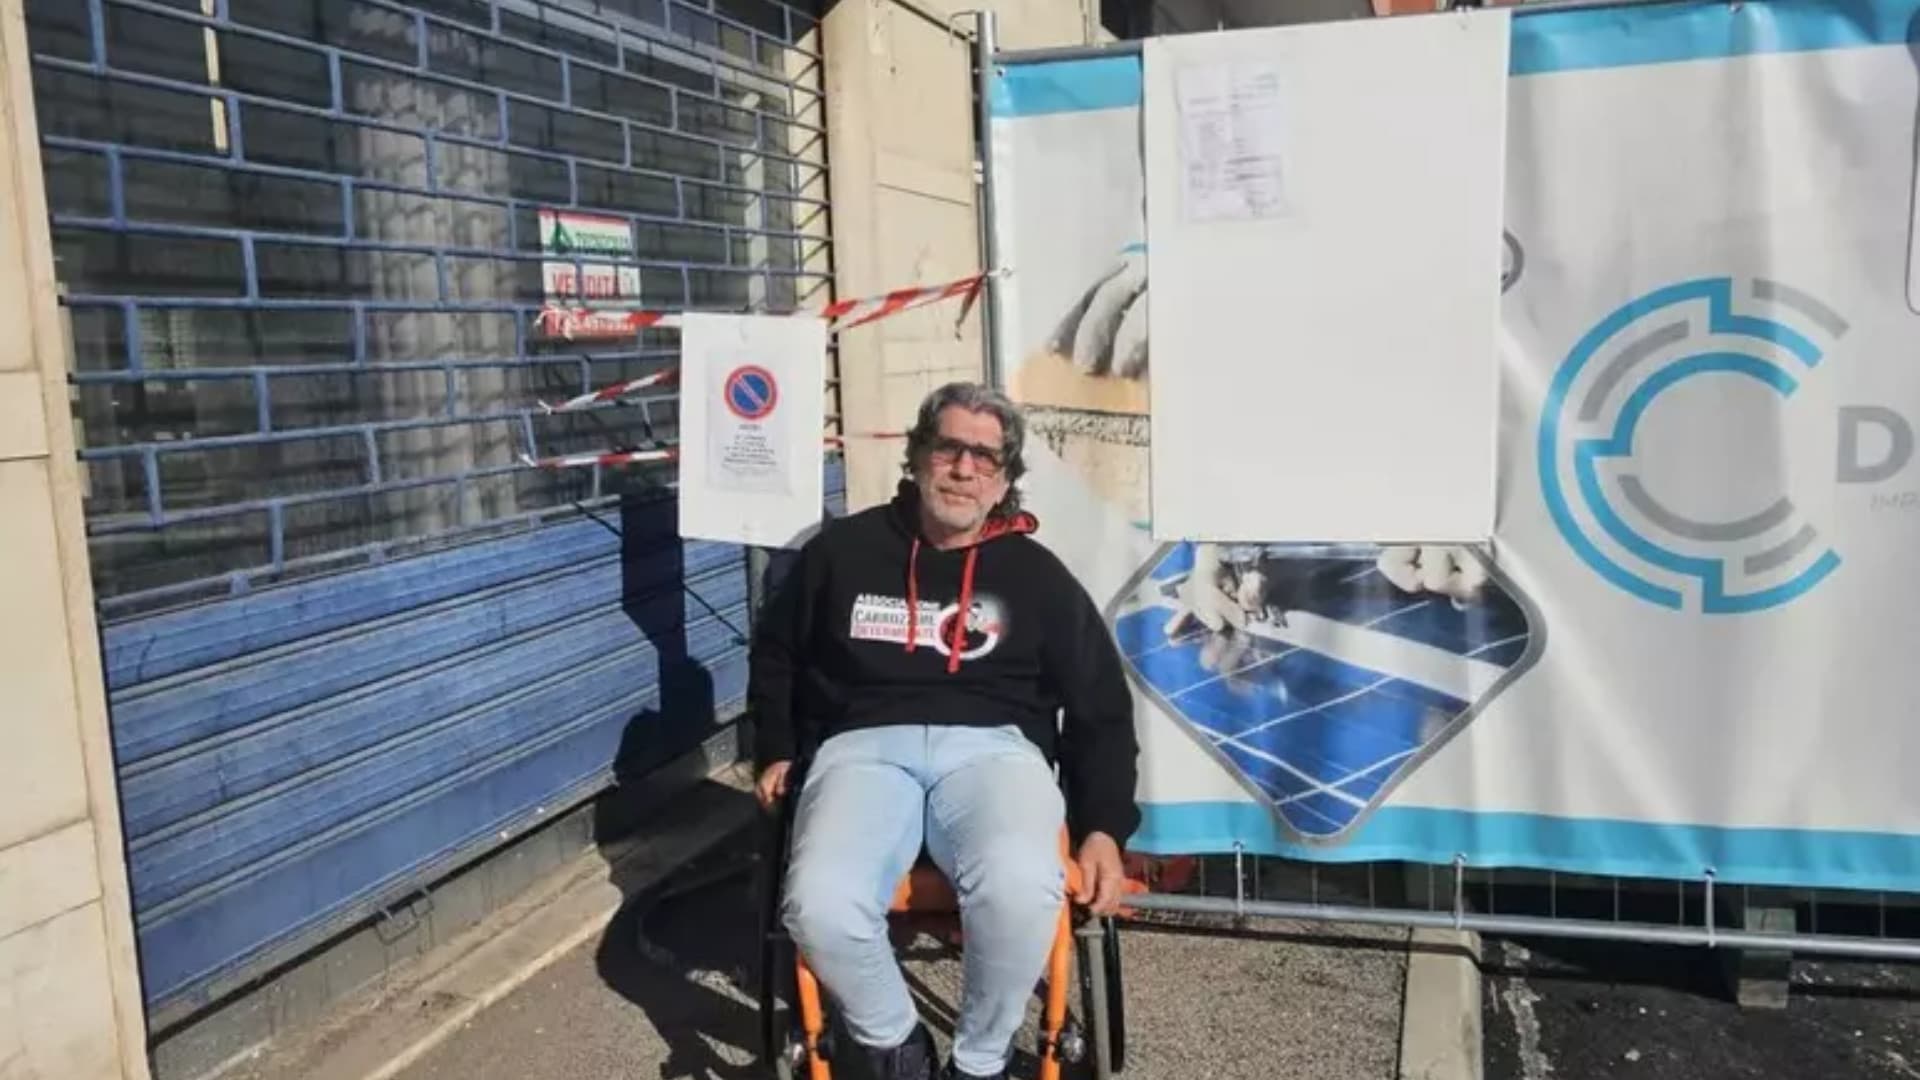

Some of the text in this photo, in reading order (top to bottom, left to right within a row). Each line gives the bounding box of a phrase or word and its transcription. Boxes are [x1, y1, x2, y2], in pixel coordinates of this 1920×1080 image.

[553, 272, 620, 298] VEDITA
[1837, 405, 1915, 483] D
[856, 593, 940, 611] ASSOCIAONE
